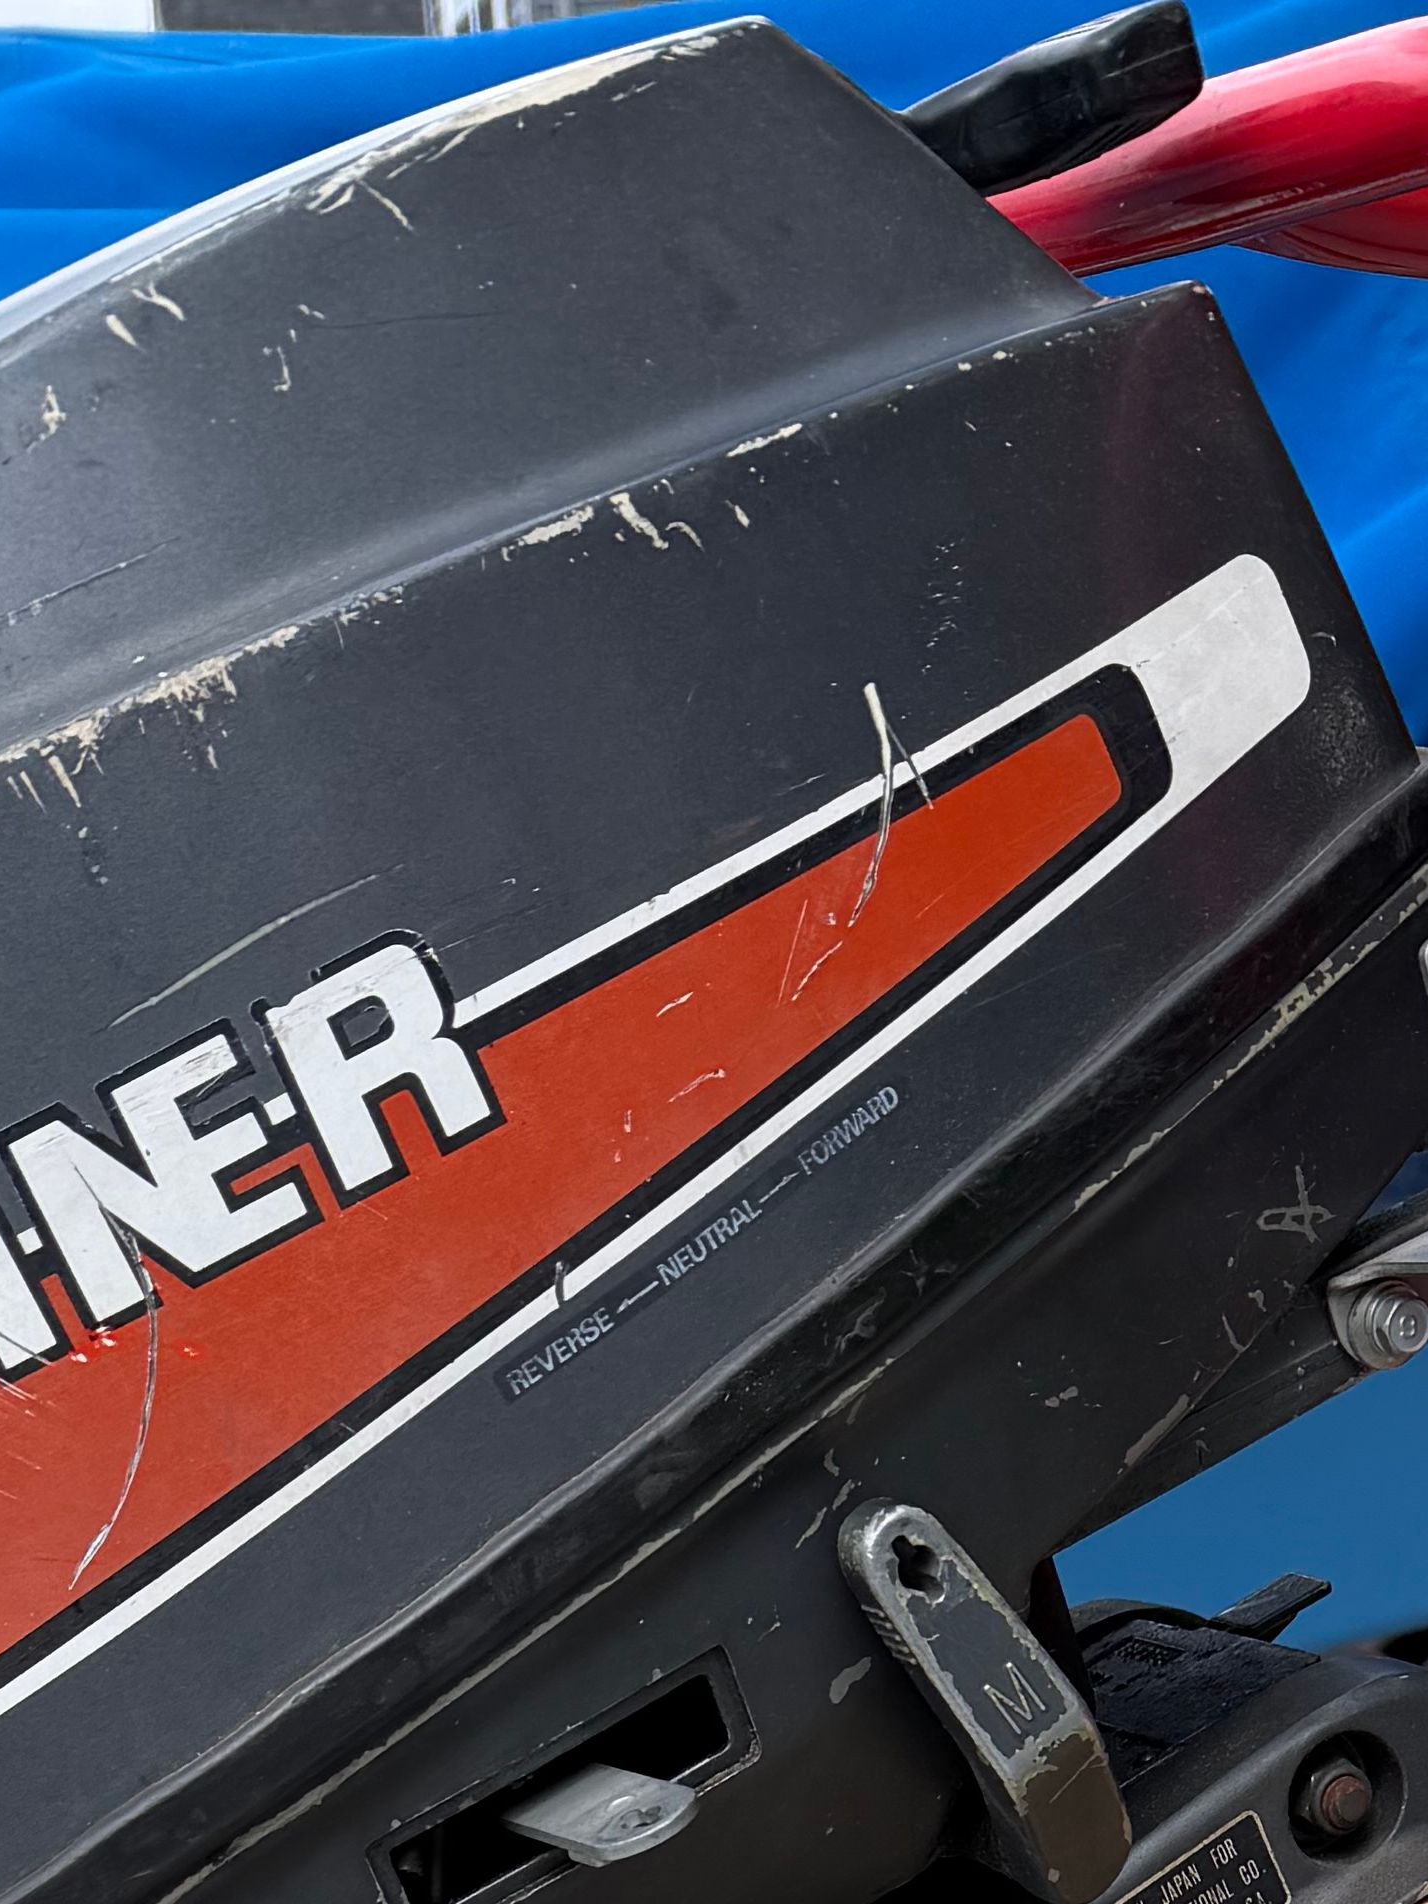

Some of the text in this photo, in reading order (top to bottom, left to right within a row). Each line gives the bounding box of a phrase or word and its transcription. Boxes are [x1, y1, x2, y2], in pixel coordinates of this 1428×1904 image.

[506, 1086, 900, 1395] REVERSE NEUTRAL FORWARD
[983, 1662, 1046, 1734] M
[1209, 1838, 1238, 1869] FOR
[1238, 1859, 1268, 1886] CO.
